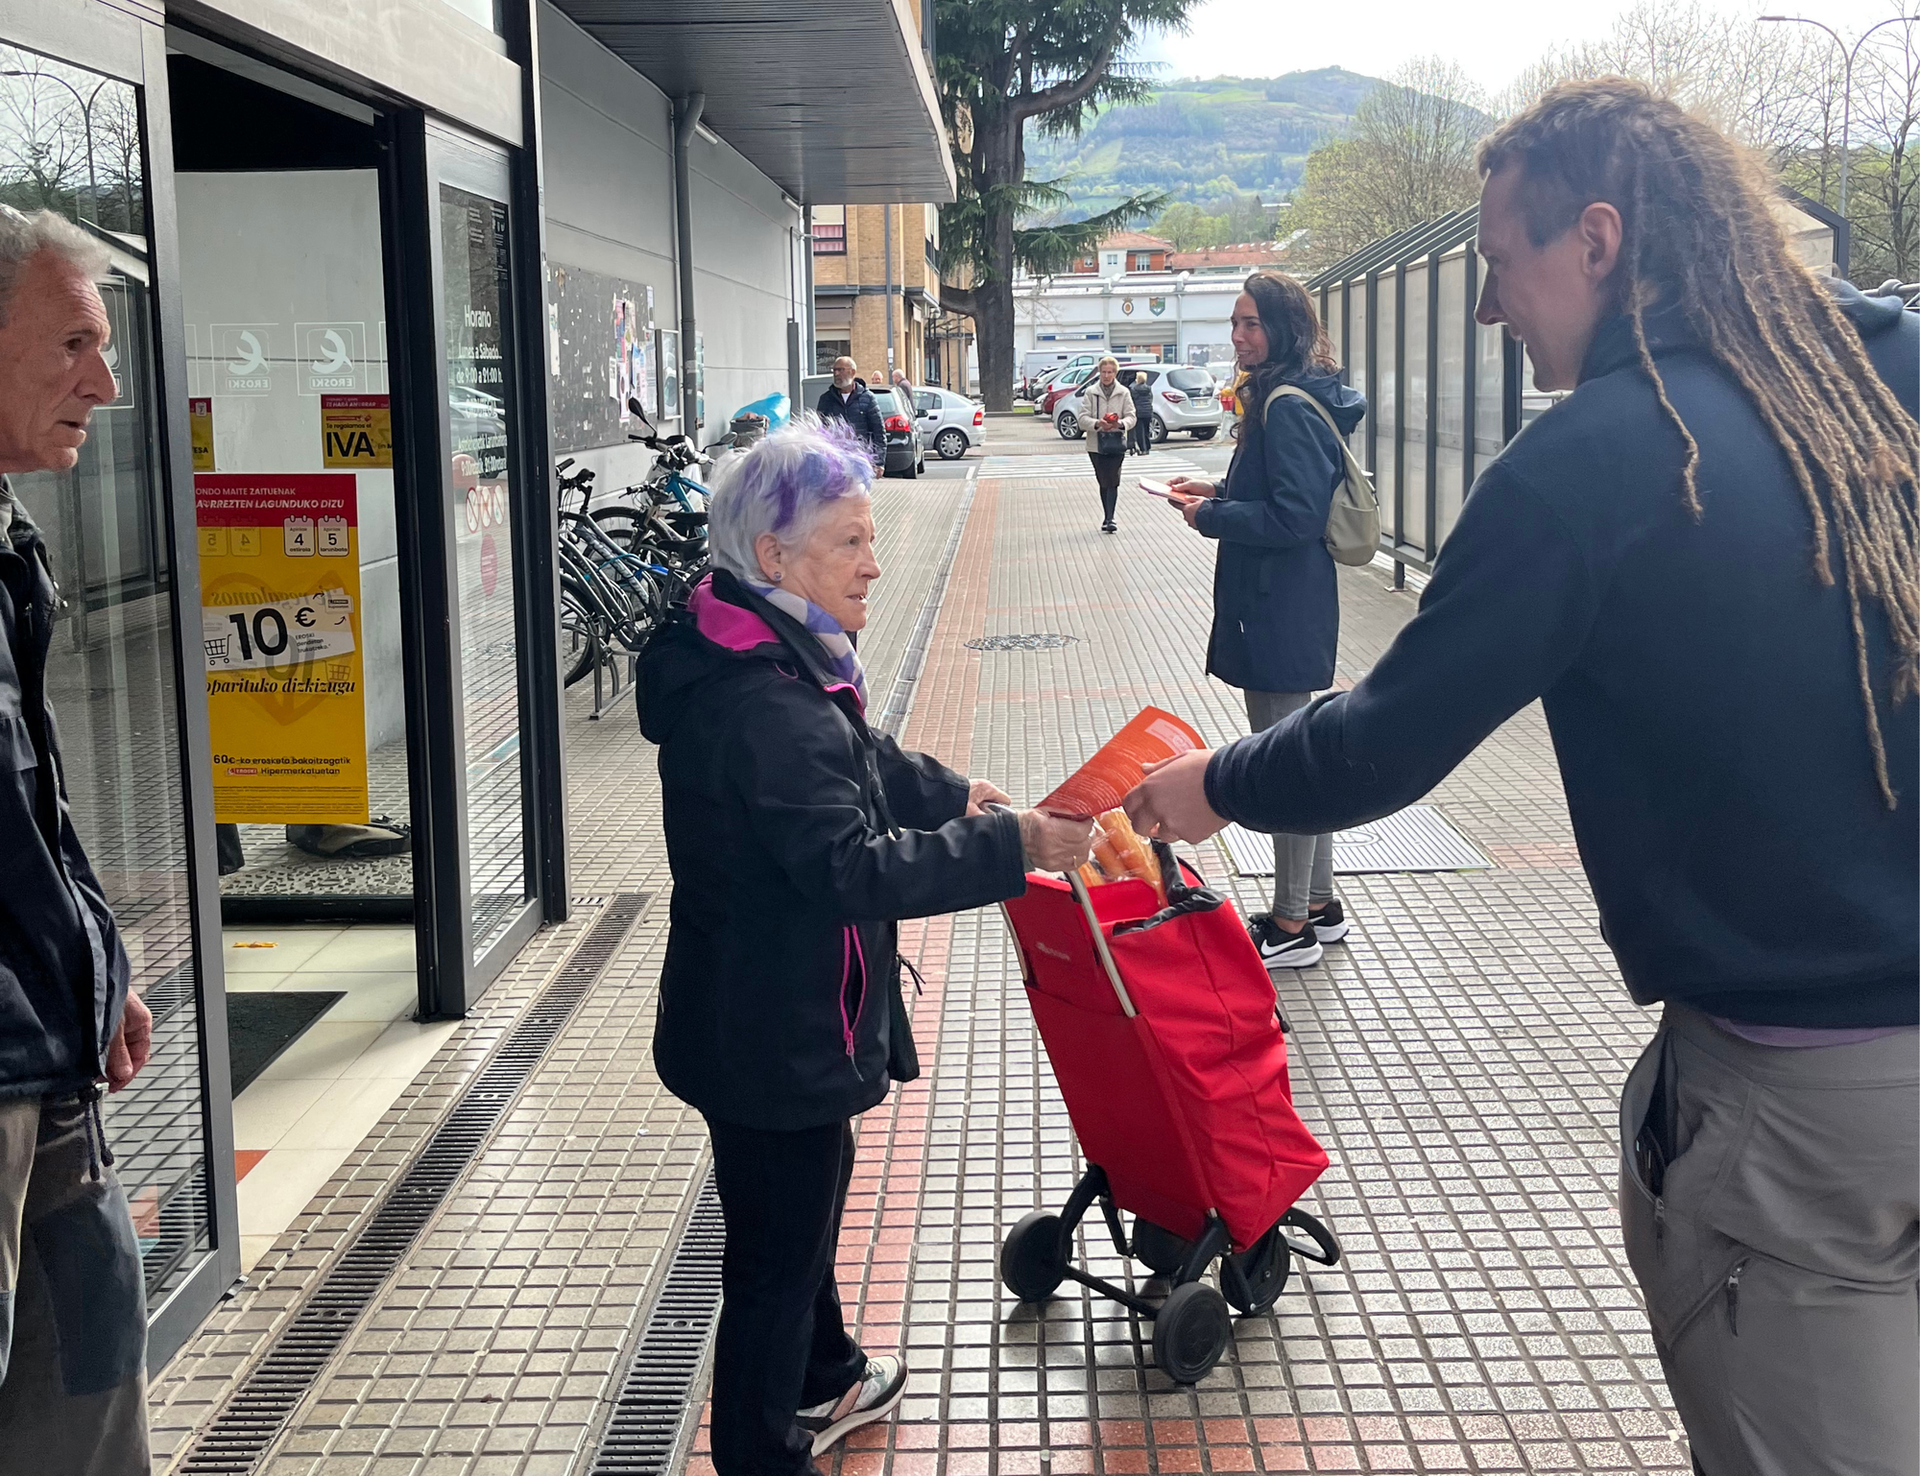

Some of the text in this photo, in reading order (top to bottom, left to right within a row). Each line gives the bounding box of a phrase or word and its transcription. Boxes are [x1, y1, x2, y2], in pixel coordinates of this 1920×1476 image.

[463, 304, 492, 328] Horario
[193, 446, 209, 454] ESA
[326, 431, 376, 457] IVA
[195, 487, 297, 496] ONDO MAITE ZAITUENAK
[254, 499, 320, 509] LAGUNDUKO
[320, 499, 345, 509] DIZU
[294, 533, 304, 546] 4
[328, 533, 338, 546] 5
[228, 606, 317, 661] 10 €
[281, 677, 356, 696] dizkizugu
